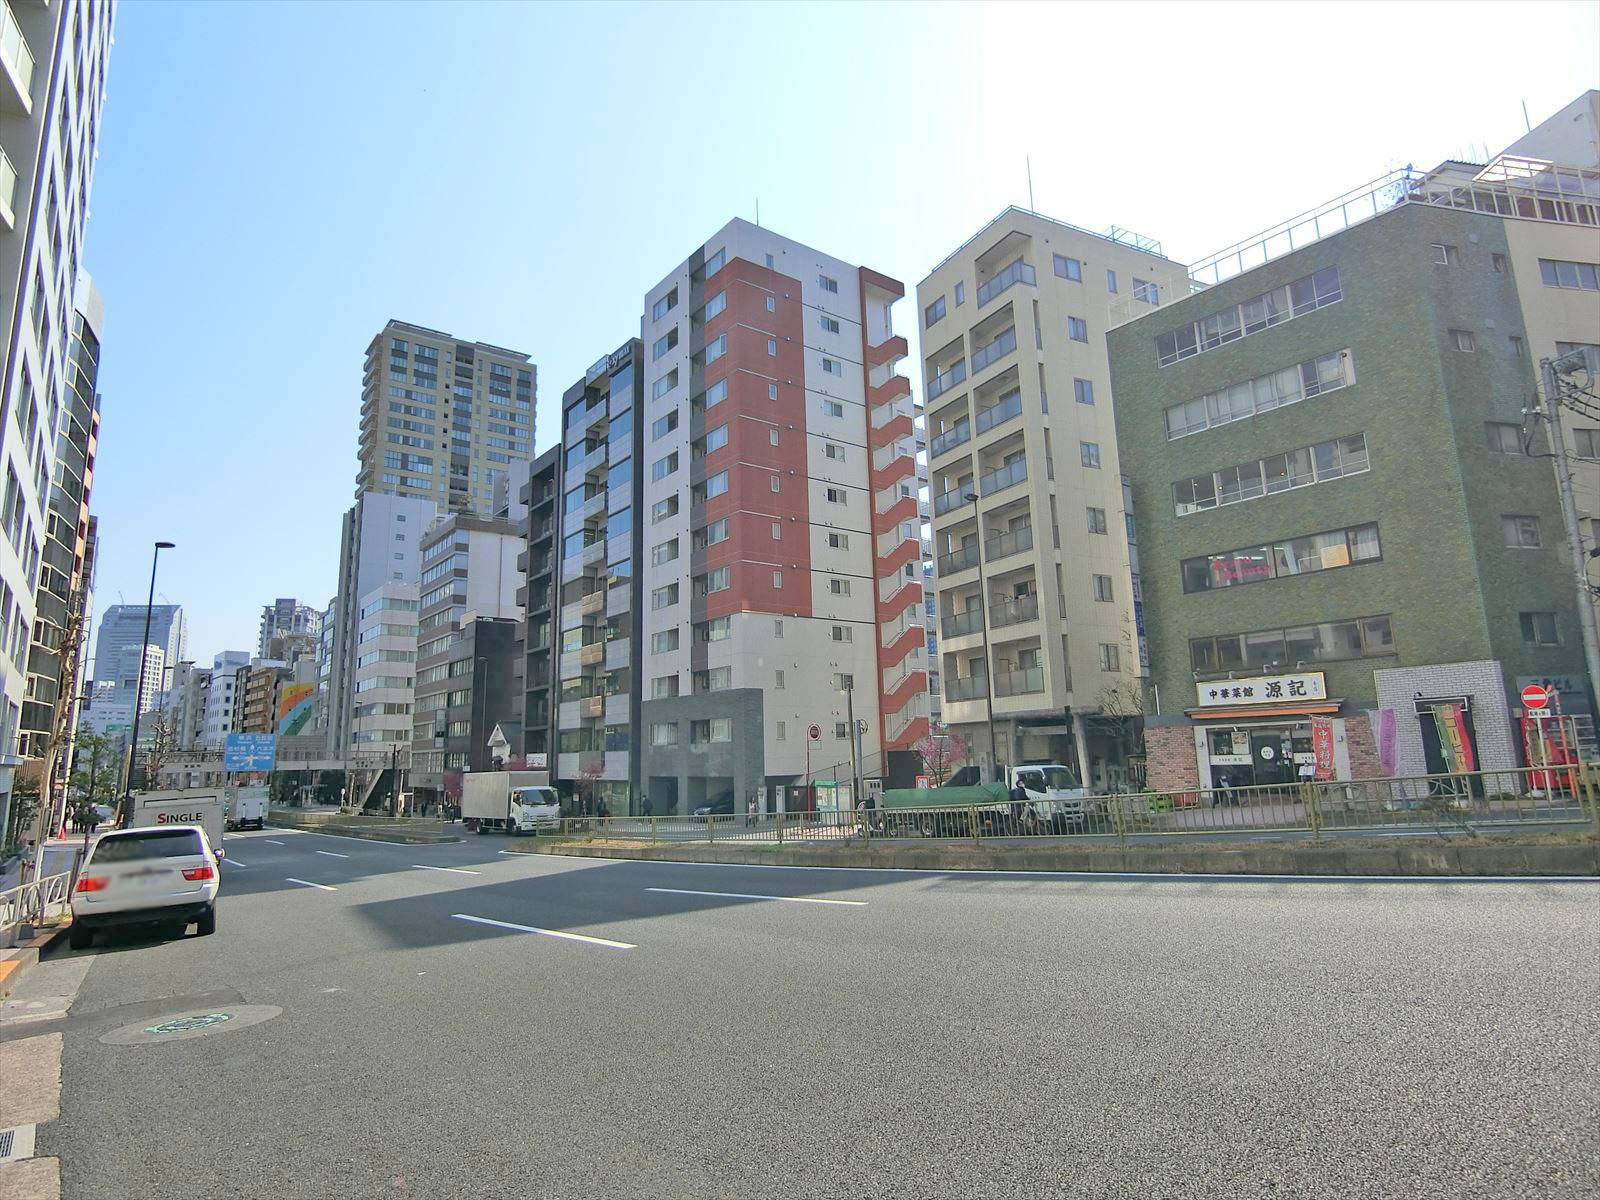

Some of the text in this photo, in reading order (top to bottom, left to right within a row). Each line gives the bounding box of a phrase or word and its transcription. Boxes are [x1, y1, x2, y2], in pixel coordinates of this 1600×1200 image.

[1208, 679, 1307, 700] 中華菜館 源記
[1318, 729, 1331, 769] 中華料理
[157, 812, 203, 824] SINGLE
